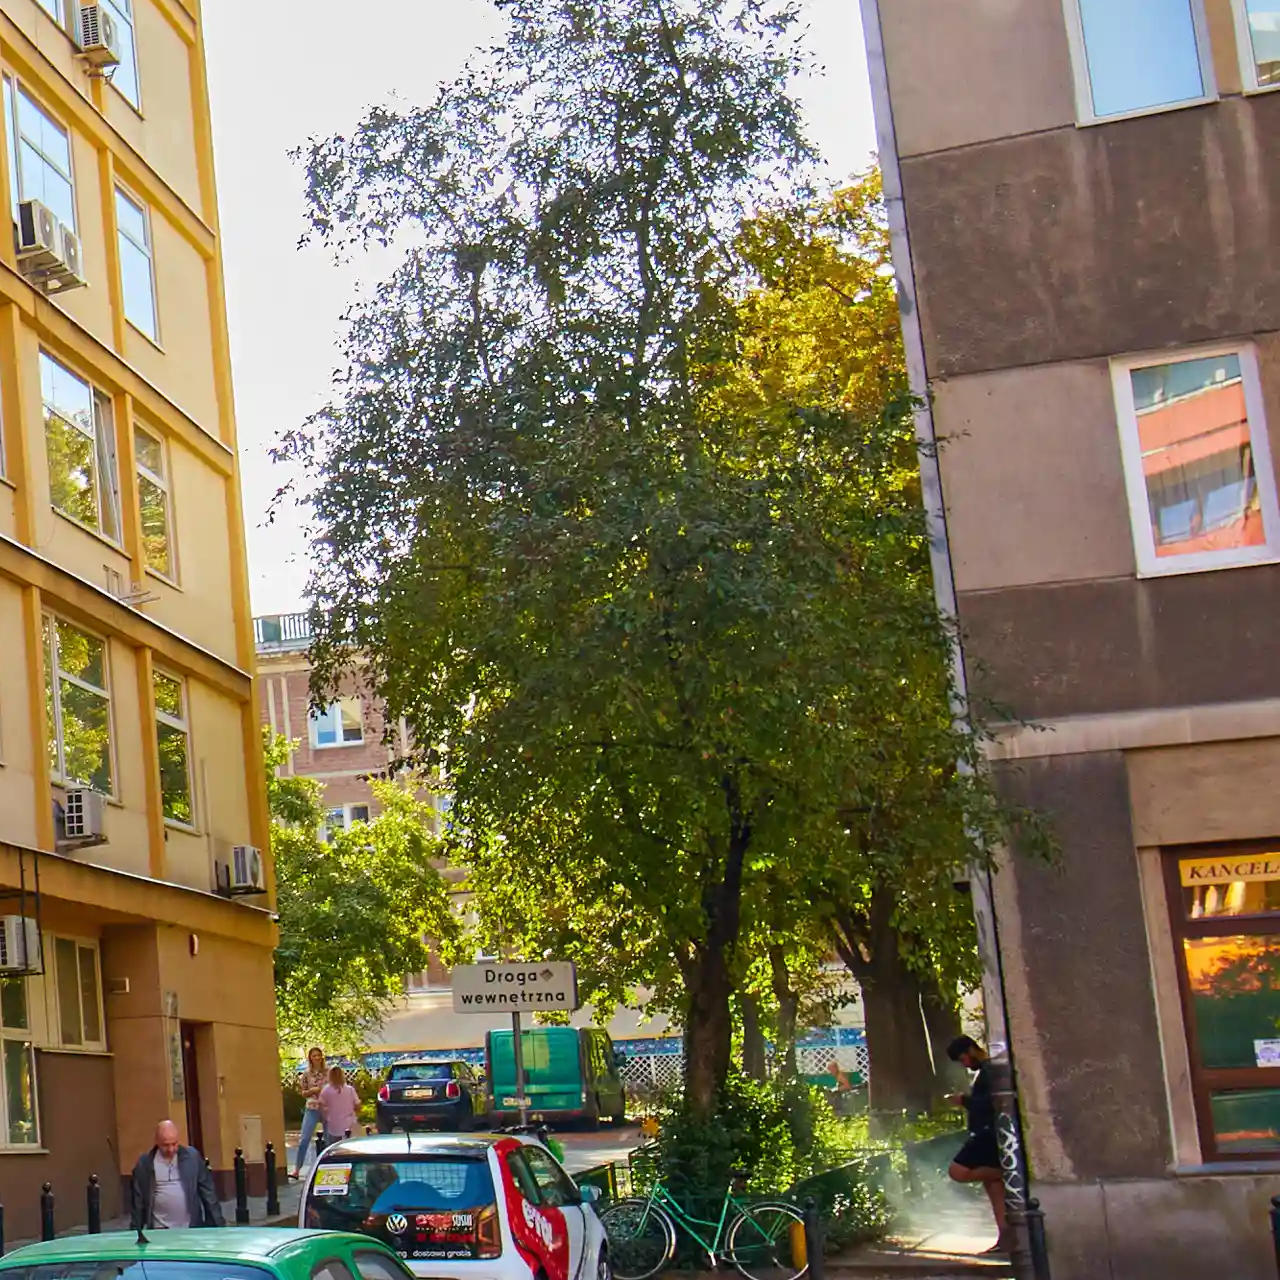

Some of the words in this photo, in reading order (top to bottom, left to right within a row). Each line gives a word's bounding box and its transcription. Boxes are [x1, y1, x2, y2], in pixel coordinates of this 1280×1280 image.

[485, 970, 538, 986] Droga
[461, 991, 566, 1007] wewnętrzna
[412, 1249, 446, 1257] dostawa
[447, 1249, 472, 1259] gratis
